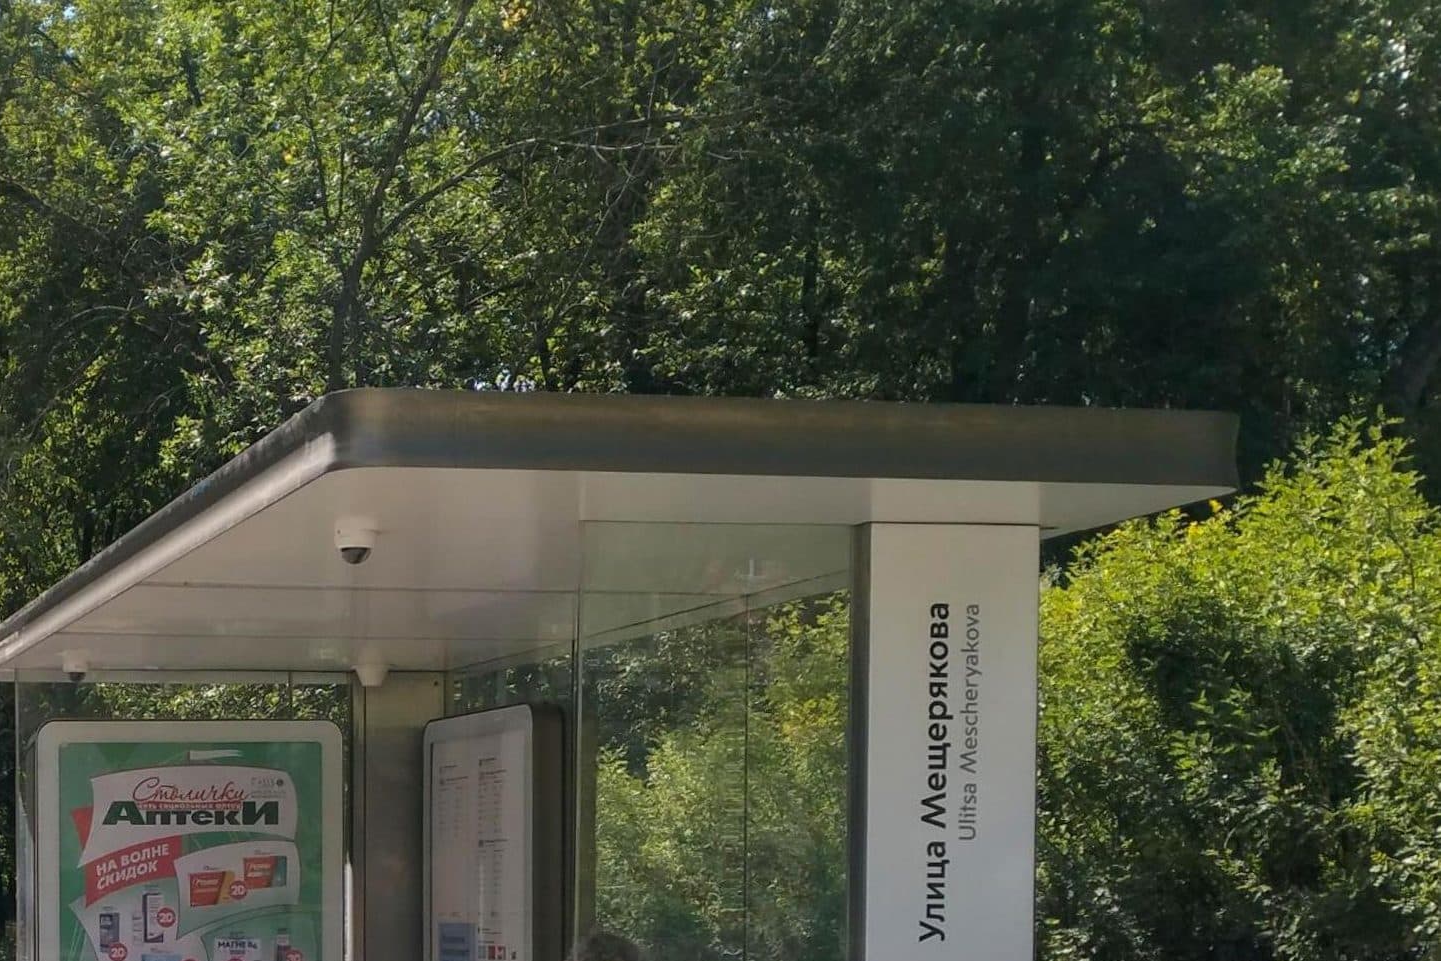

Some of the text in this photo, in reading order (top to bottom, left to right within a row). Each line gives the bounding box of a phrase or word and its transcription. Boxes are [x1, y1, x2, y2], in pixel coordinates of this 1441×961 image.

[958, 604, 983, 841] Ulitsa Mescheryakova
[918, 602, 953, 942] Улица Мещерякова
[132, 776, 250, 801] Столички
[96, 843, 170, 877] НА ВОЛНЕ
[96, 860, 159, 890] СКИДОК
[230, 884, 245, 896] 20
[158, 914, 172, 923] 20
[111, 948, 124, 957] 20
